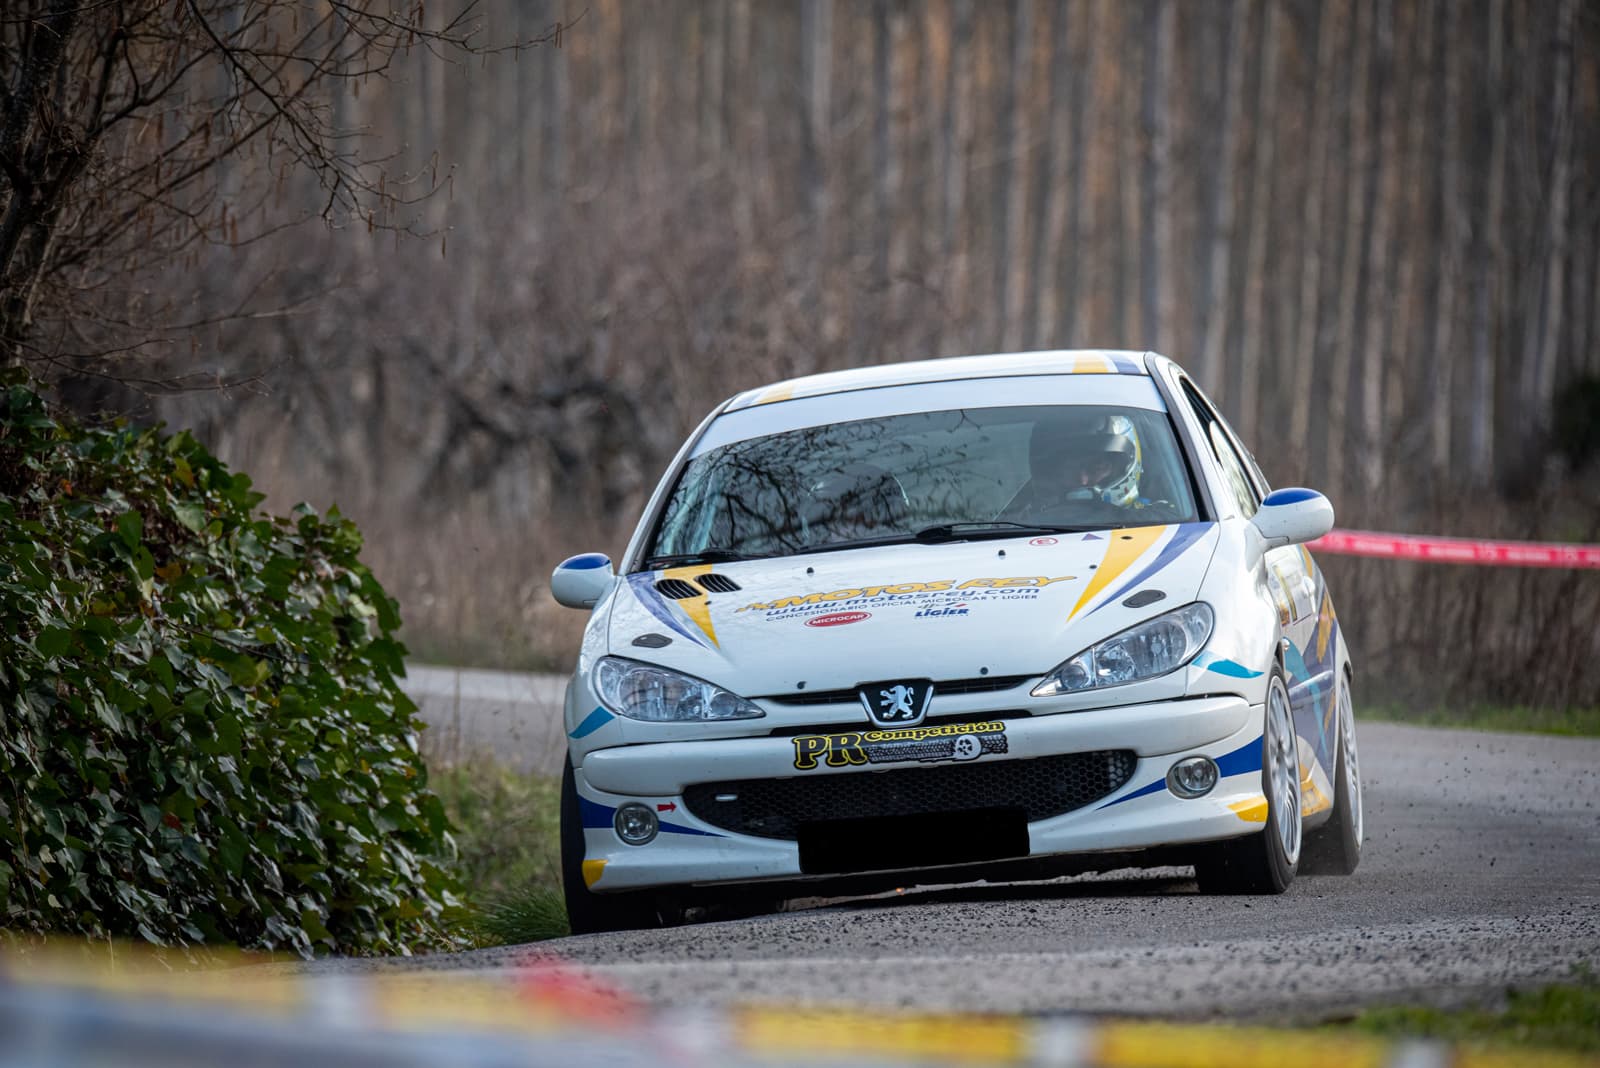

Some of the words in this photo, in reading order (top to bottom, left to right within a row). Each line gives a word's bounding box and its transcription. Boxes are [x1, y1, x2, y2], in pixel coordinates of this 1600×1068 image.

[764, 580, 957, 610] MOTOS
[955, 576, 1077, 590] REY
[766, 588, 1040, 617] www.motosrey.com
[766, 604, 867, 622] CONCESIONARIO
[871, 599, 916, 608] OFICIAL
[921, 595, 988, 604] MICROCAR
[811, 613, 865, 625] MICROCAR
[793, 732, 868, 770] PR
[863, 721, 1005, 742] Competición
